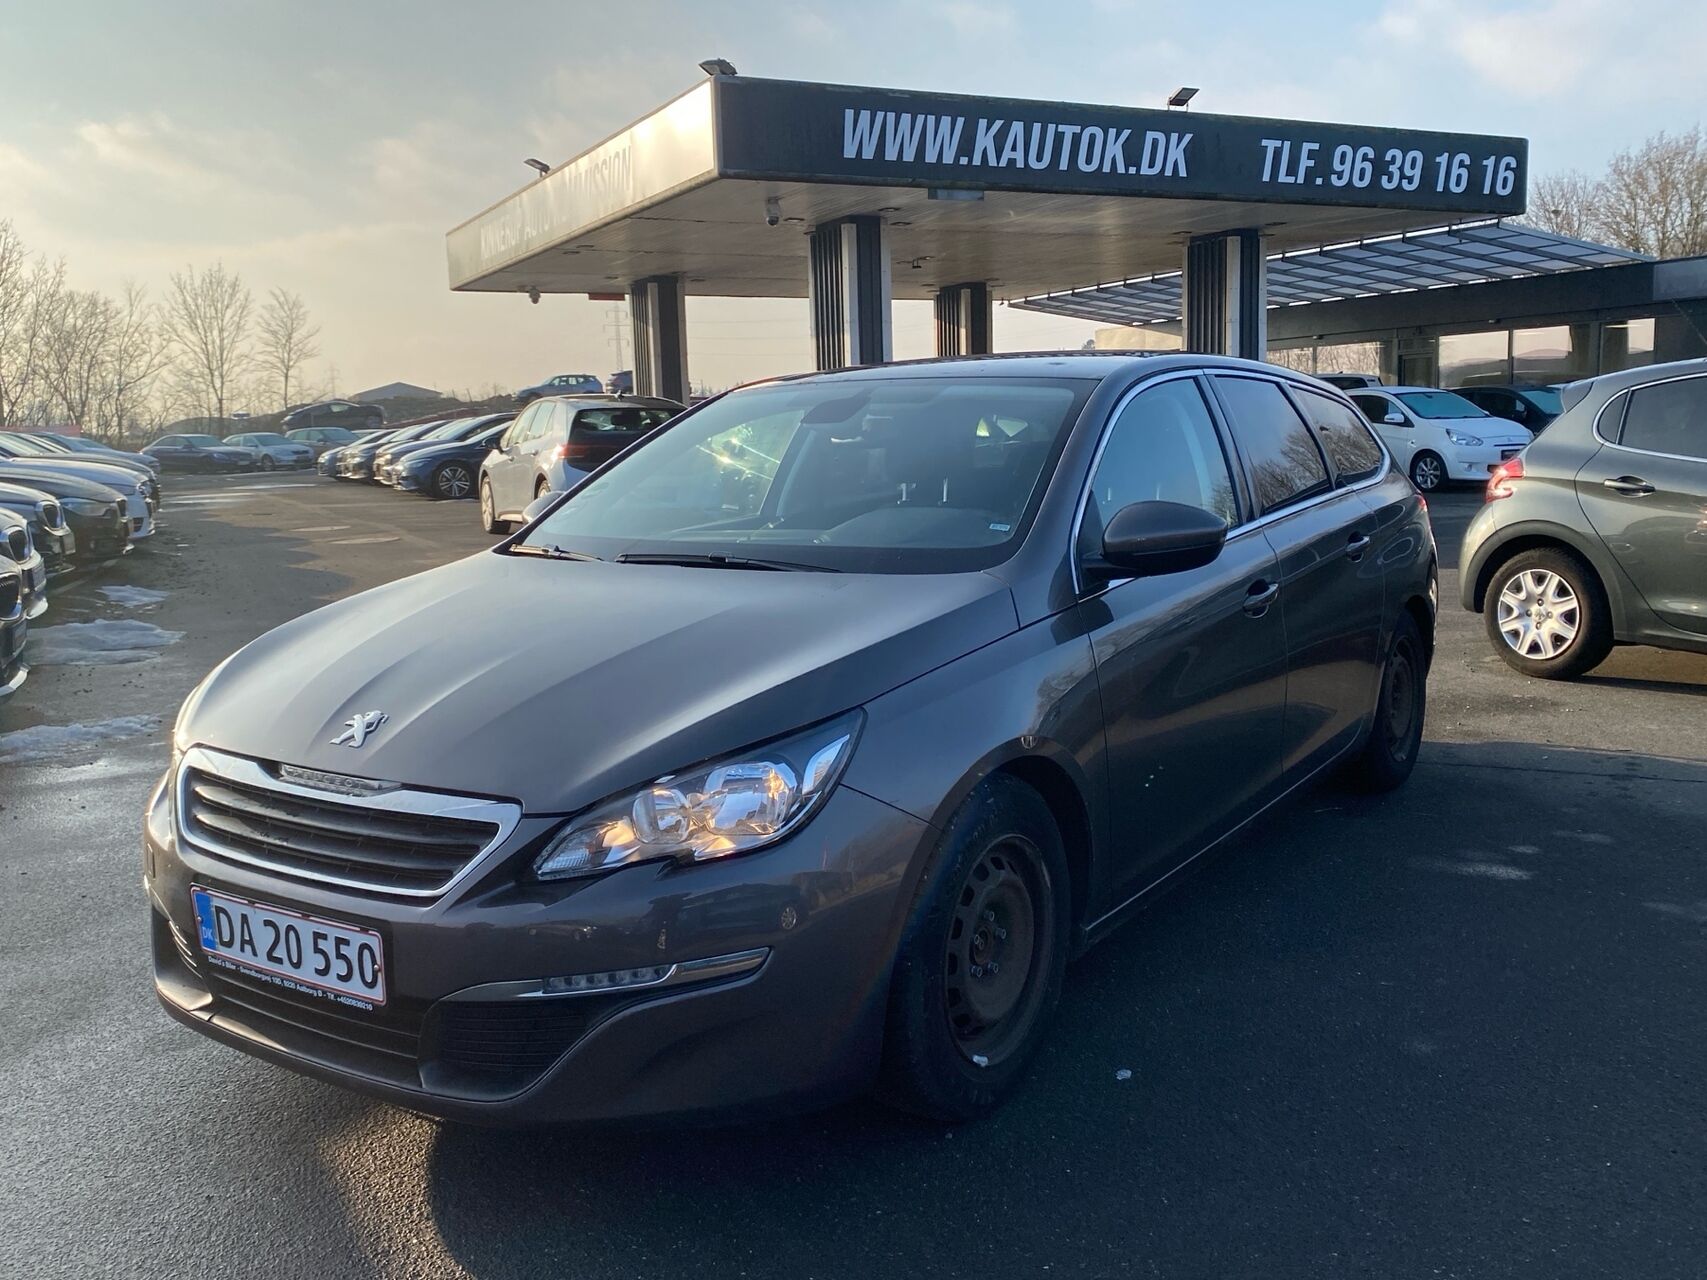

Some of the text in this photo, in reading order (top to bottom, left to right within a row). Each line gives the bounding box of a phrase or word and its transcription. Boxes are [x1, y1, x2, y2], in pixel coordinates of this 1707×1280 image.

[842, 108, 1194, 178] WWW.KAUTOK.DK
[1261, 139, 1516, 197] TLF. 96 39 16 16
[202, 927, 213, 940] DK
[214, 905, 379, 990] DA 20 550
